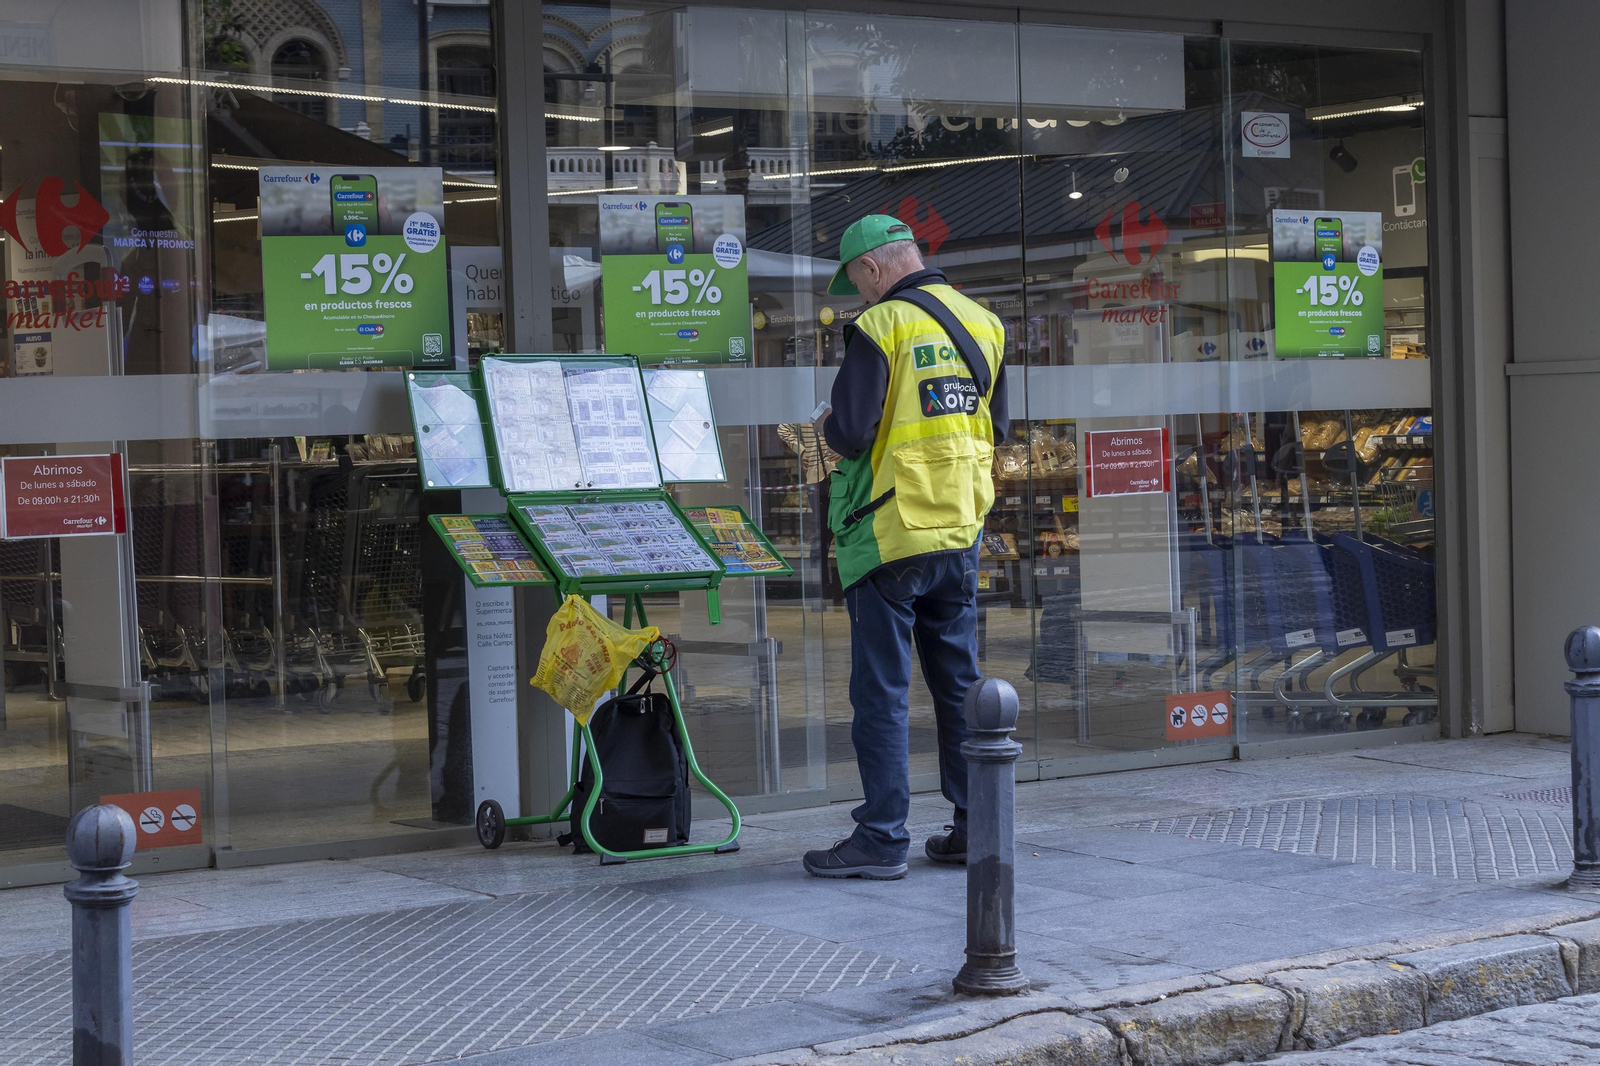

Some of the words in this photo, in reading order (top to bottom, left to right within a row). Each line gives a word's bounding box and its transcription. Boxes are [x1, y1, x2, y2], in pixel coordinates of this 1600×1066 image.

[263, 174, 302, 183] Carrefour
[1196, 217, 1222, 226] SALIDA
[132, 228, 148, 238] Con
[150, 229, 178, 238] nuestra
[406, 228, 438, 237] GRATIS!
[114, 238, 147, 248] MARCA
[149, 239, 155, 248] Y
[157, 239, 195, 249] PROMOS
[716, 247, 740, 255] GRATIS!
[300, 253, 414, 295] -15%
[3, 272, 124, 299] arrefour
[632, 269, 722, 304] -15%
[1086, 277, 1181, 299] Carrefour
[1296, 275, 1364, 306] -15%
[320, 300, 373, 312] productos
[375, 300, 412, 308] frescos
[6, 305, 108, 331] market
[648, 309, 690, 319] productos
[1102, 305, 1167, 326] market
[1308, 309, 1339, 318] productos
[354, 357, 362, 365] ES
[1110, 437, 1143, 446] Abrimos
[33, 465, 82, 476] Abrimos
[66, 479, 96, 488] sábado
[18, 497, 30, 505] De
[32, 496, 61, 505] 09:00h
[71, 494, 100, 503] 21:30h
